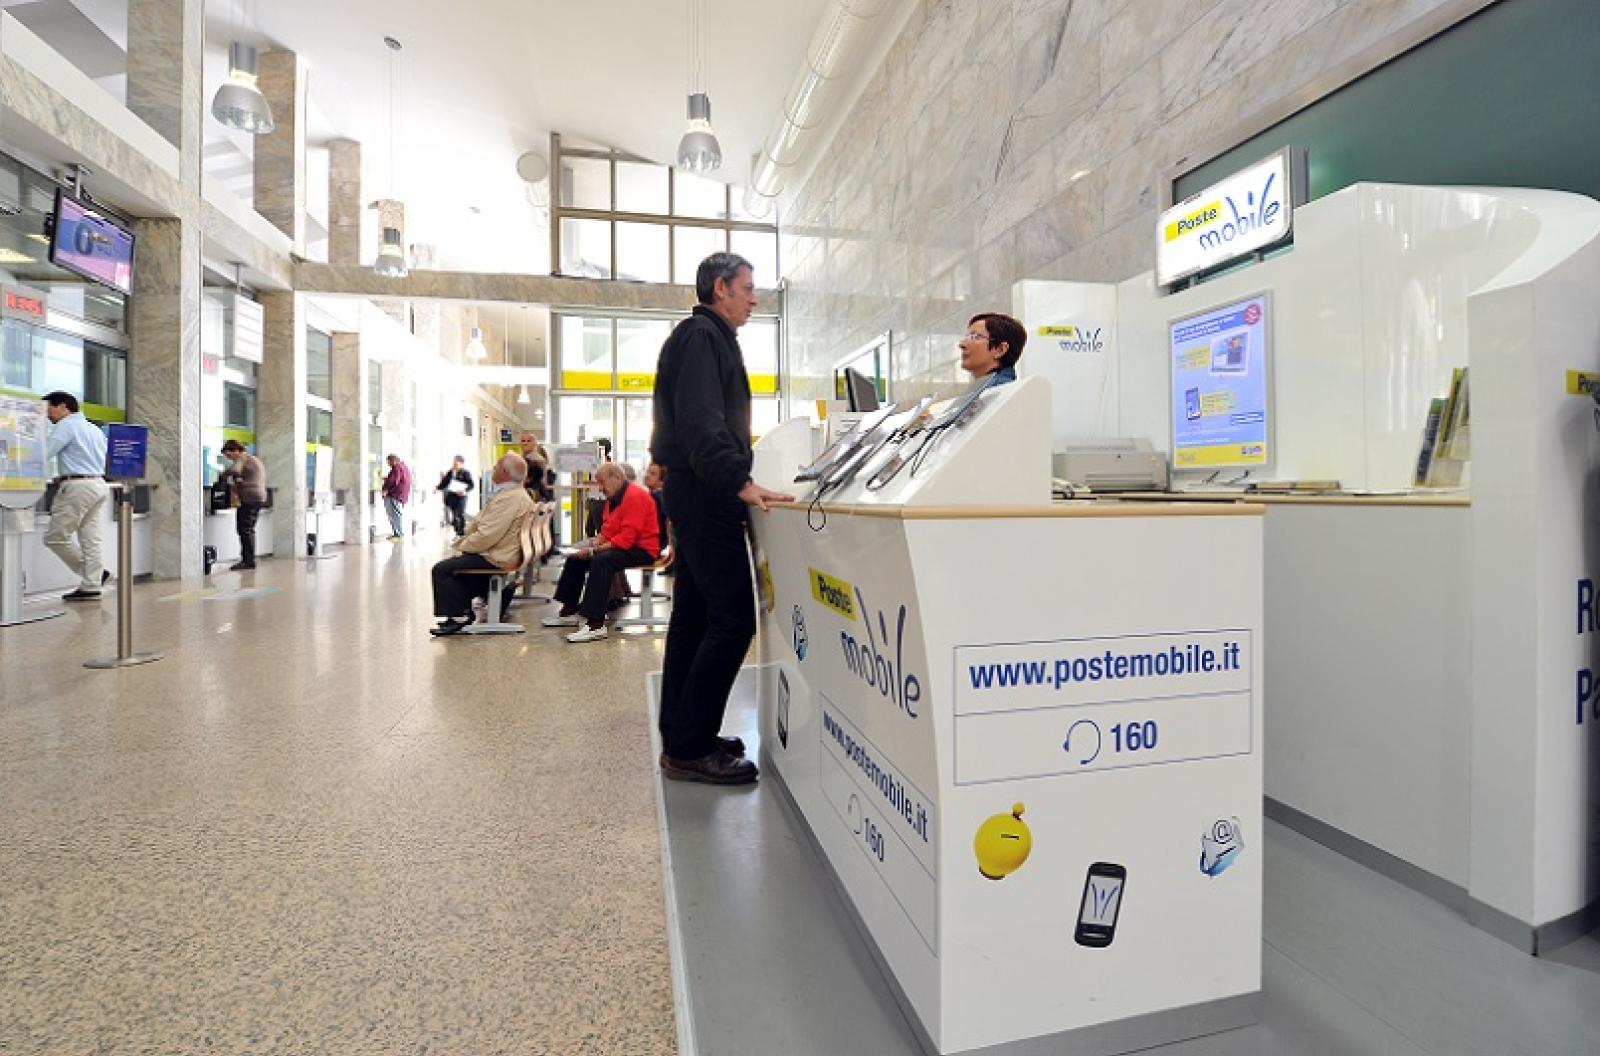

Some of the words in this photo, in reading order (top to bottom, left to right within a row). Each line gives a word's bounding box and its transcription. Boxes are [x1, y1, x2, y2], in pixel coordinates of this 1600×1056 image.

[1178, 208, 1217, 235] Poste
[1199, 172, 1281, 250] mobile
[1059, 326, 1103, 353] mobile
[817, 573, 853, 614] Poste
[840, 585, 921, 718] mobile
[968, 642, 1241, 690] www.postemobile.it
[1110, 719, 1158, 753] 160
[823, 710, 928, 843] www.postemobile.it
[864, 817, 885, 863] 160
